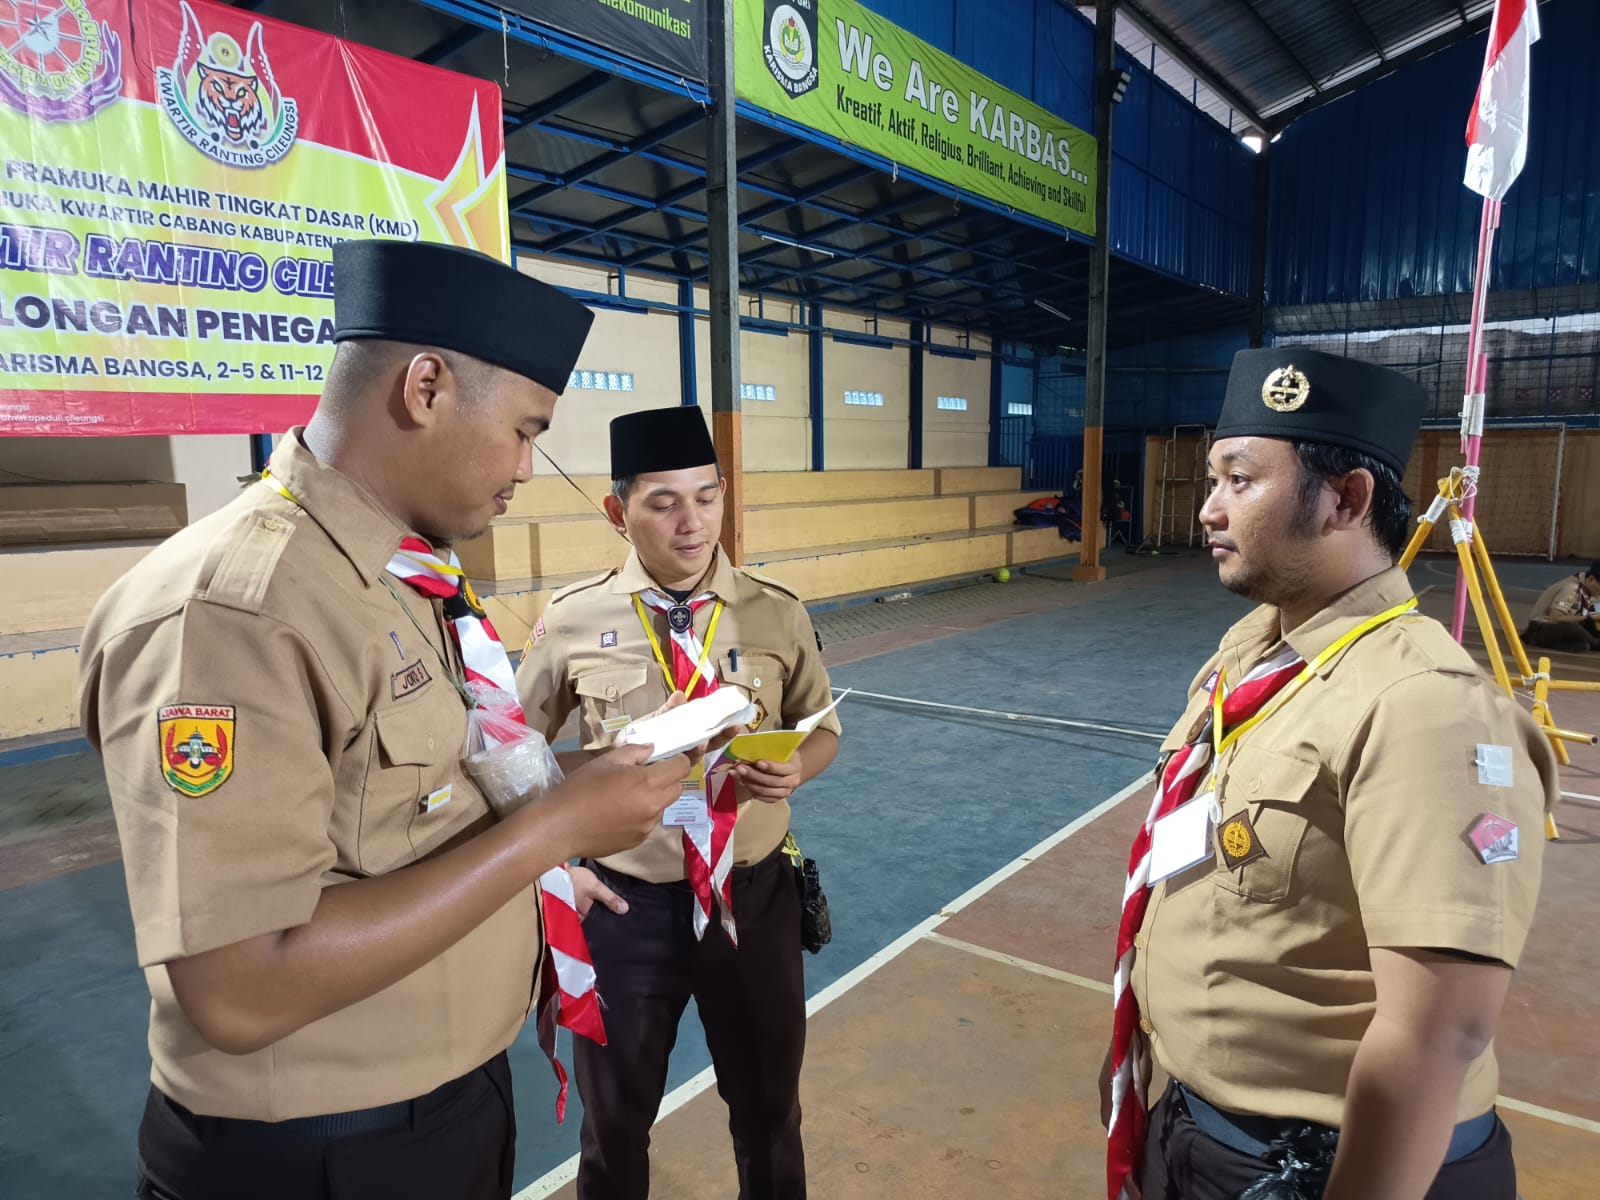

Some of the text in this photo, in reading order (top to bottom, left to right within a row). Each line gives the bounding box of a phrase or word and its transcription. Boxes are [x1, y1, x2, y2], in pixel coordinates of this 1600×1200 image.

[793, 67, 818, 93] BANGSA
[835, 17, 894, 91] We
[904, 58, 960, 123] Are
[160, 70, 296, 164] KWARTIR RANTING CILEUNGSI
[837, 84, 884, 132] Kreatif,
[888, 108, 918, 145] Aktif,
[921, 122, 964, 165] Religius,
[967, 144, 1006, 182] Brilliant,
[1008, 163, 1046, 202] Achieving
[1047, 184, 1061, 204] and
[6, 160, 420, 241] PRAMUKA MAHIR TINGKAT DASAR (KMD)
[61, 199, 155, 226] KWARTIR
[159, 213, 236, 236] CABANG
[240, 225, 333, 248] KABUPATEN
[83, 232, 268, 293] RANTING
[104, 357, 212, 381] BANGSA,
[260, 363, 276, 379] &
[162, 707, 231, 718] JAWA BARAT
